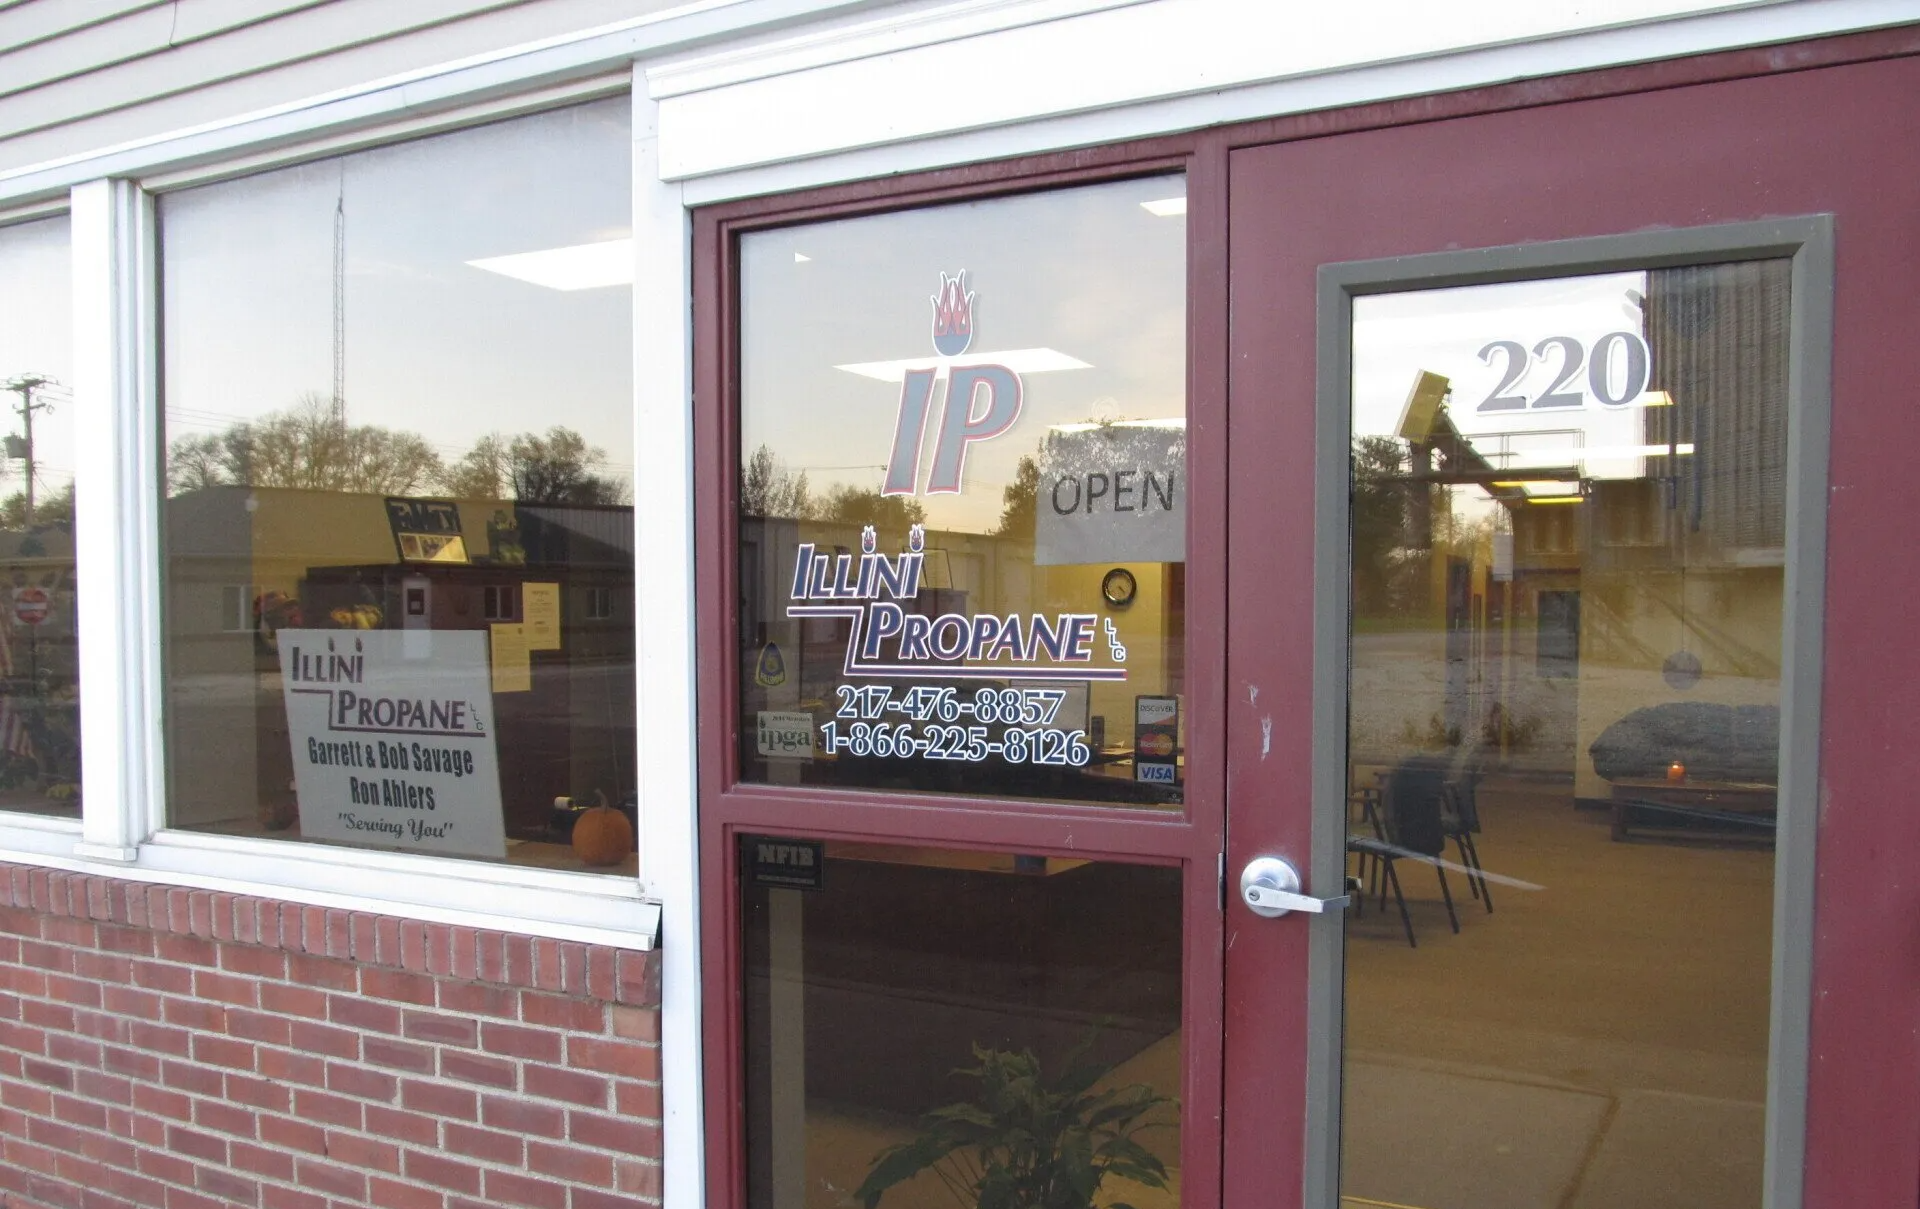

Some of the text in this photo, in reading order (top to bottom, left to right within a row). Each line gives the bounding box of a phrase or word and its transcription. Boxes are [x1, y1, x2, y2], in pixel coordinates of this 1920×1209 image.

[1476, 331, 1651, 412] 220
[881, 363, 1024, 497] IP
[1052, 470, 1175, 516] OPEN
[862, 602, 1126, 662] PROPANE LLC
[337, 690, 484, 731] PROPANE LLC
[836, 685, 1066, 724] 217-476-8857
[308, 737, 474, 777] Garrett & Bob Savage
[760, 730, 812, 751] ipga
[821, 721, 1090, 765] 1-866-225-8126
[350, 776, 435, 811] Ron Ahlers
[1142, 767, 1173, 780] VISA
[758, 845, 814, 866] NFIB
